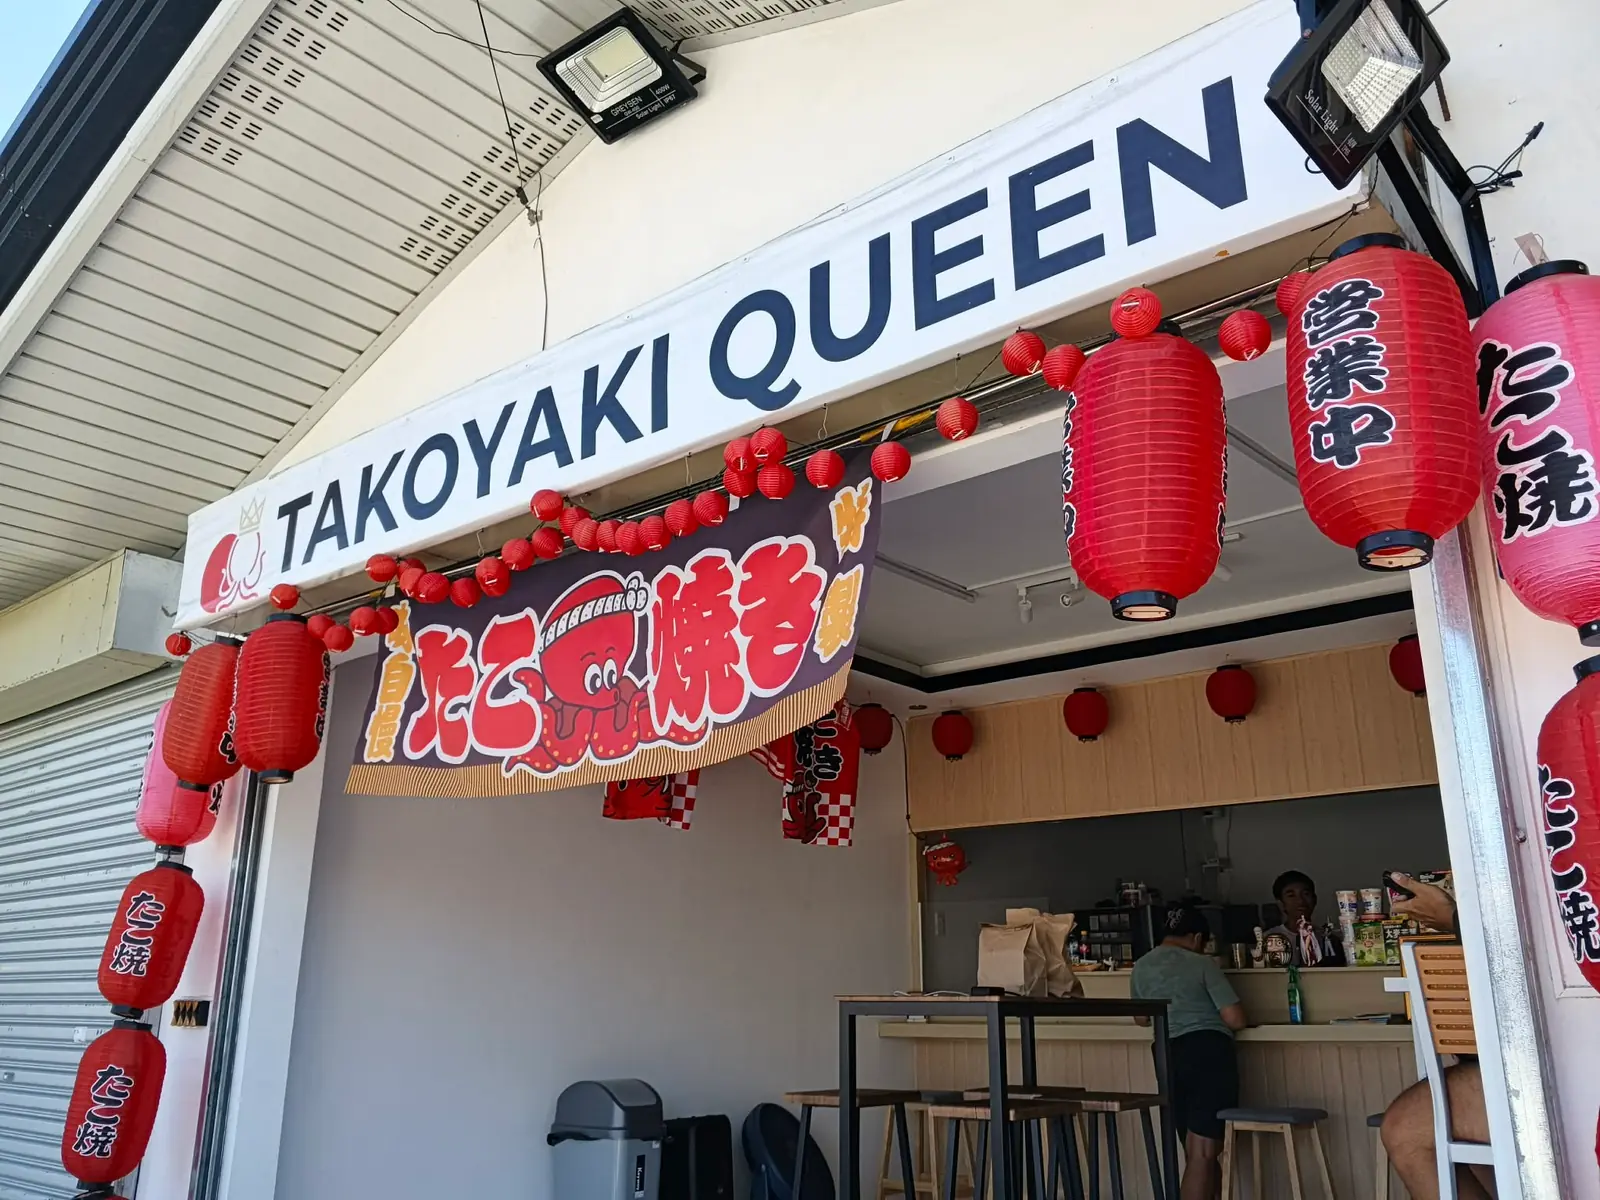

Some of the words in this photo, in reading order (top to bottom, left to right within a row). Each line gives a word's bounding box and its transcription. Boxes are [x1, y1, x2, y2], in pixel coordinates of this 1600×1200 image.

[610, 96, 643, 117] GREYSEN
[635, 110, 650, 120] Solar
[648, 103, 663, 113] Light
[1304, 89, 1323, 113] Solar
[1320, 109, 1339, 134] Light
[278, 333, 669, 572] TAKOYAKI
[710, 76, 1247, 411] QUEEN
[1301, 278, 1397, 470] 営業中
[1476, 338, 1600, 545] たこ焼
[109, 890, 165, 977] たこ焼
[72, 1064, 134, 1158] たこ焼
